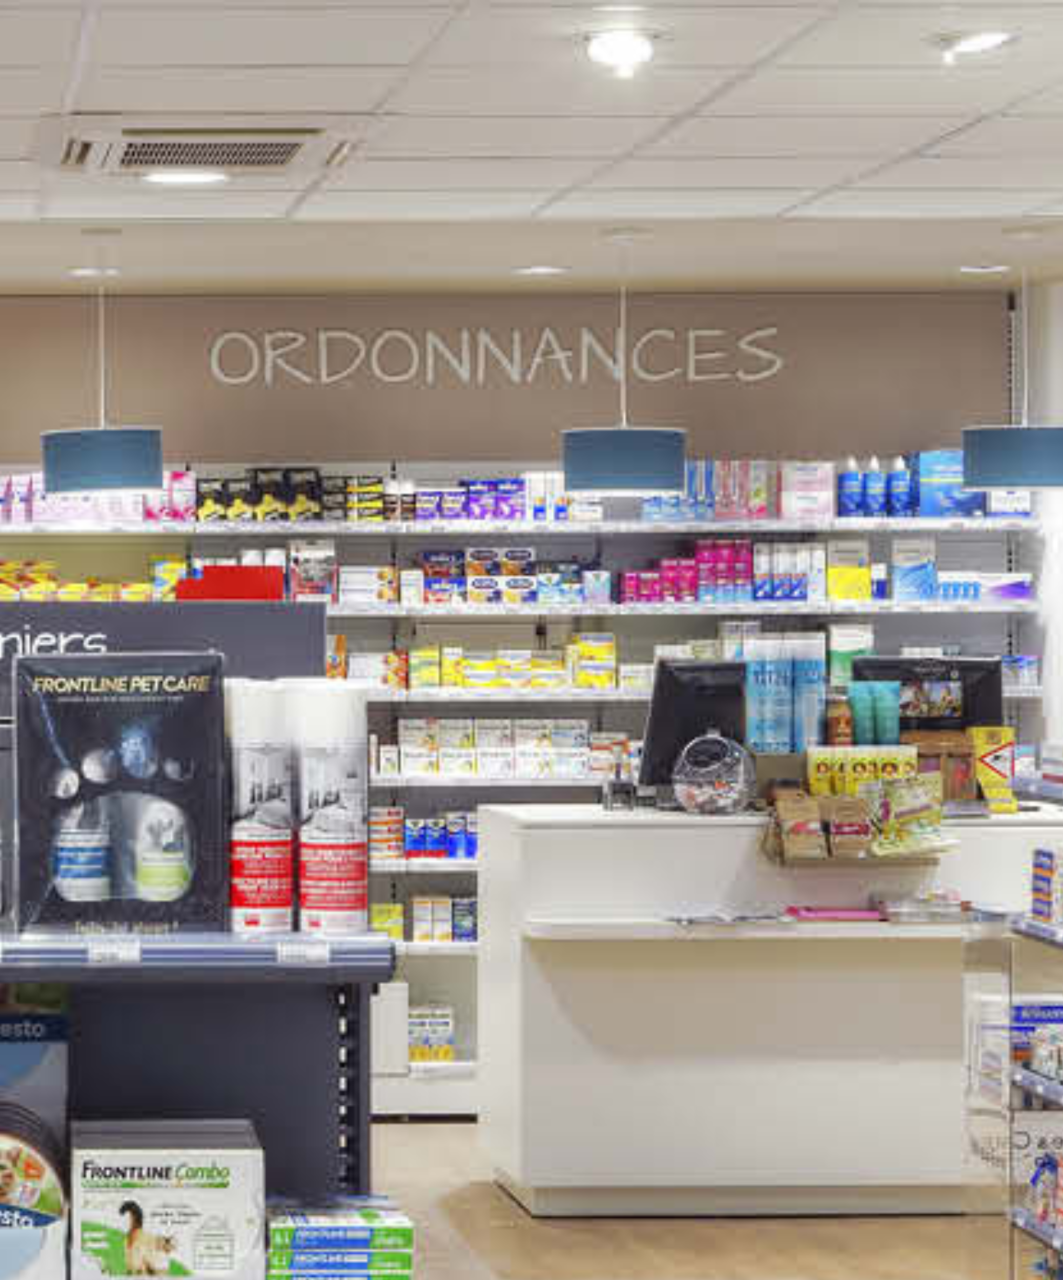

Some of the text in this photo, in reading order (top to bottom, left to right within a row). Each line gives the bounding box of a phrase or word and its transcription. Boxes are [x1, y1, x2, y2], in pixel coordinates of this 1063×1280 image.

[209, 327, 784, 386] ORDONNANCES
[32, 675, 127, 693] FRONTLINE
[82, 1159, 231, 1181] FRONTLINE Combo
